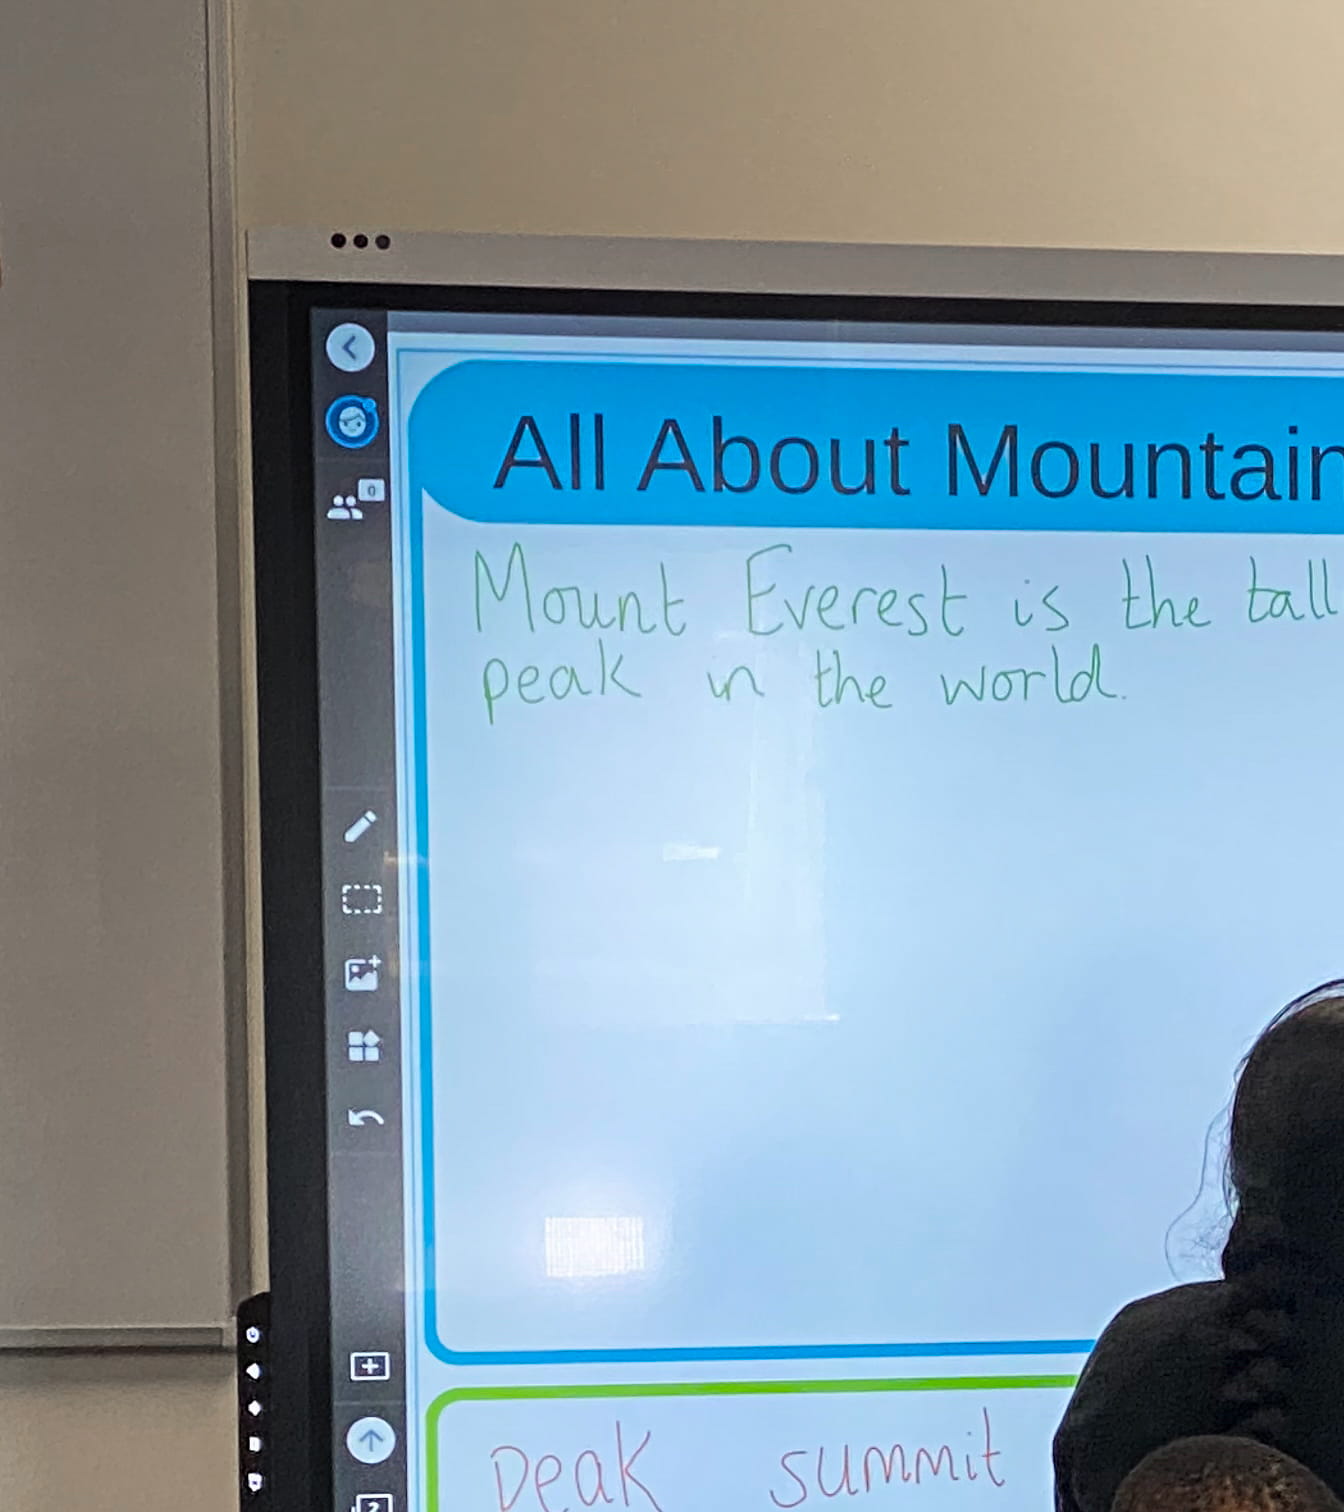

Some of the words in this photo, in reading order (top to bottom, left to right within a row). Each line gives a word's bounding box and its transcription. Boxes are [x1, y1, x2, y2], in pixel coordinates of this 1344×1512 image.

[493, 412, 605, 491] All
[636, 415, 911, 496] About
[474, 541, 686, 637] Mount
[745, 543, 968, 637] Everest
[1014, 578, 1070, 632] is
[1121, 554, 1212, 629] the
[482, 637, 643, 726] peak
[706, 654, 766, 702] in
[813, 649, 893, 709] the
[940, 642, 1128, 706] world.
[769, 1406, 1006, 1509] summit
